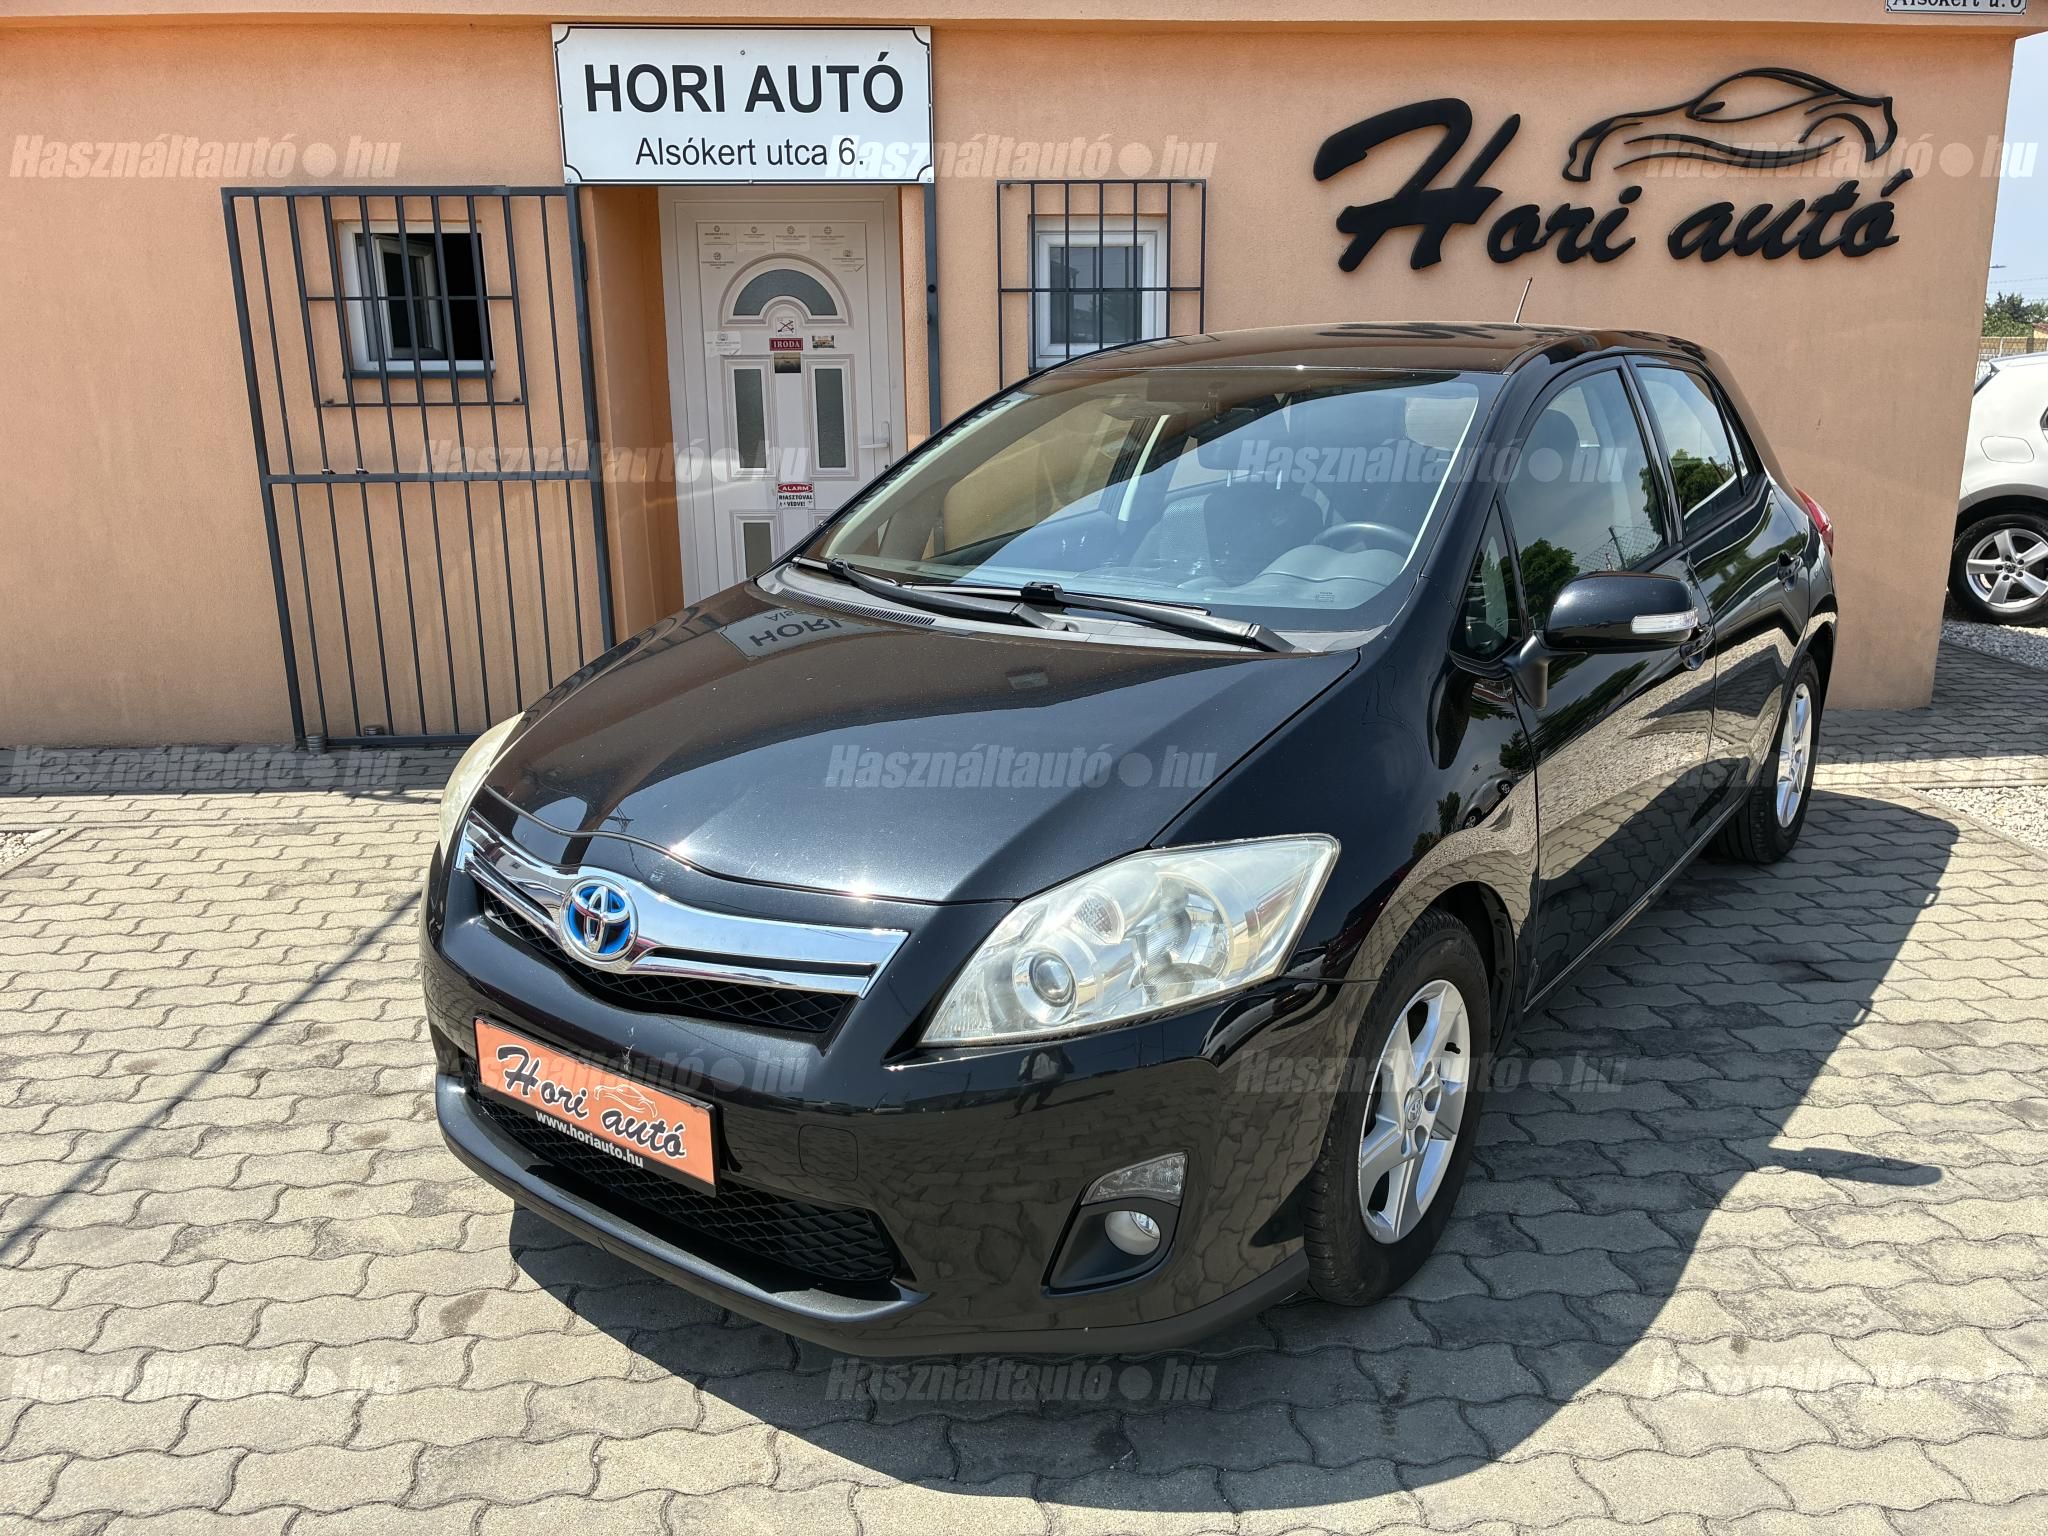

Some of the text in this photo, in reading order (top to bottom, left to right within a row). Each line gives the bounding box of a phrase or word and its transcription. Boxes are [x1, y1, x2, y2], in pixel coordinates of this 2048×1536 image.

[584, 52, 904, 113] HORI AUTÓ
[635, 136, 865, 166] Alsókert utca 6.
[1313, 97, 1914, 271] Hori autó
[773, 340, 801, 348] IRODA
[497, 1044, 687, 1159] Hori autó
[535, 1110, 644, 1168] www.horiauto.hu
